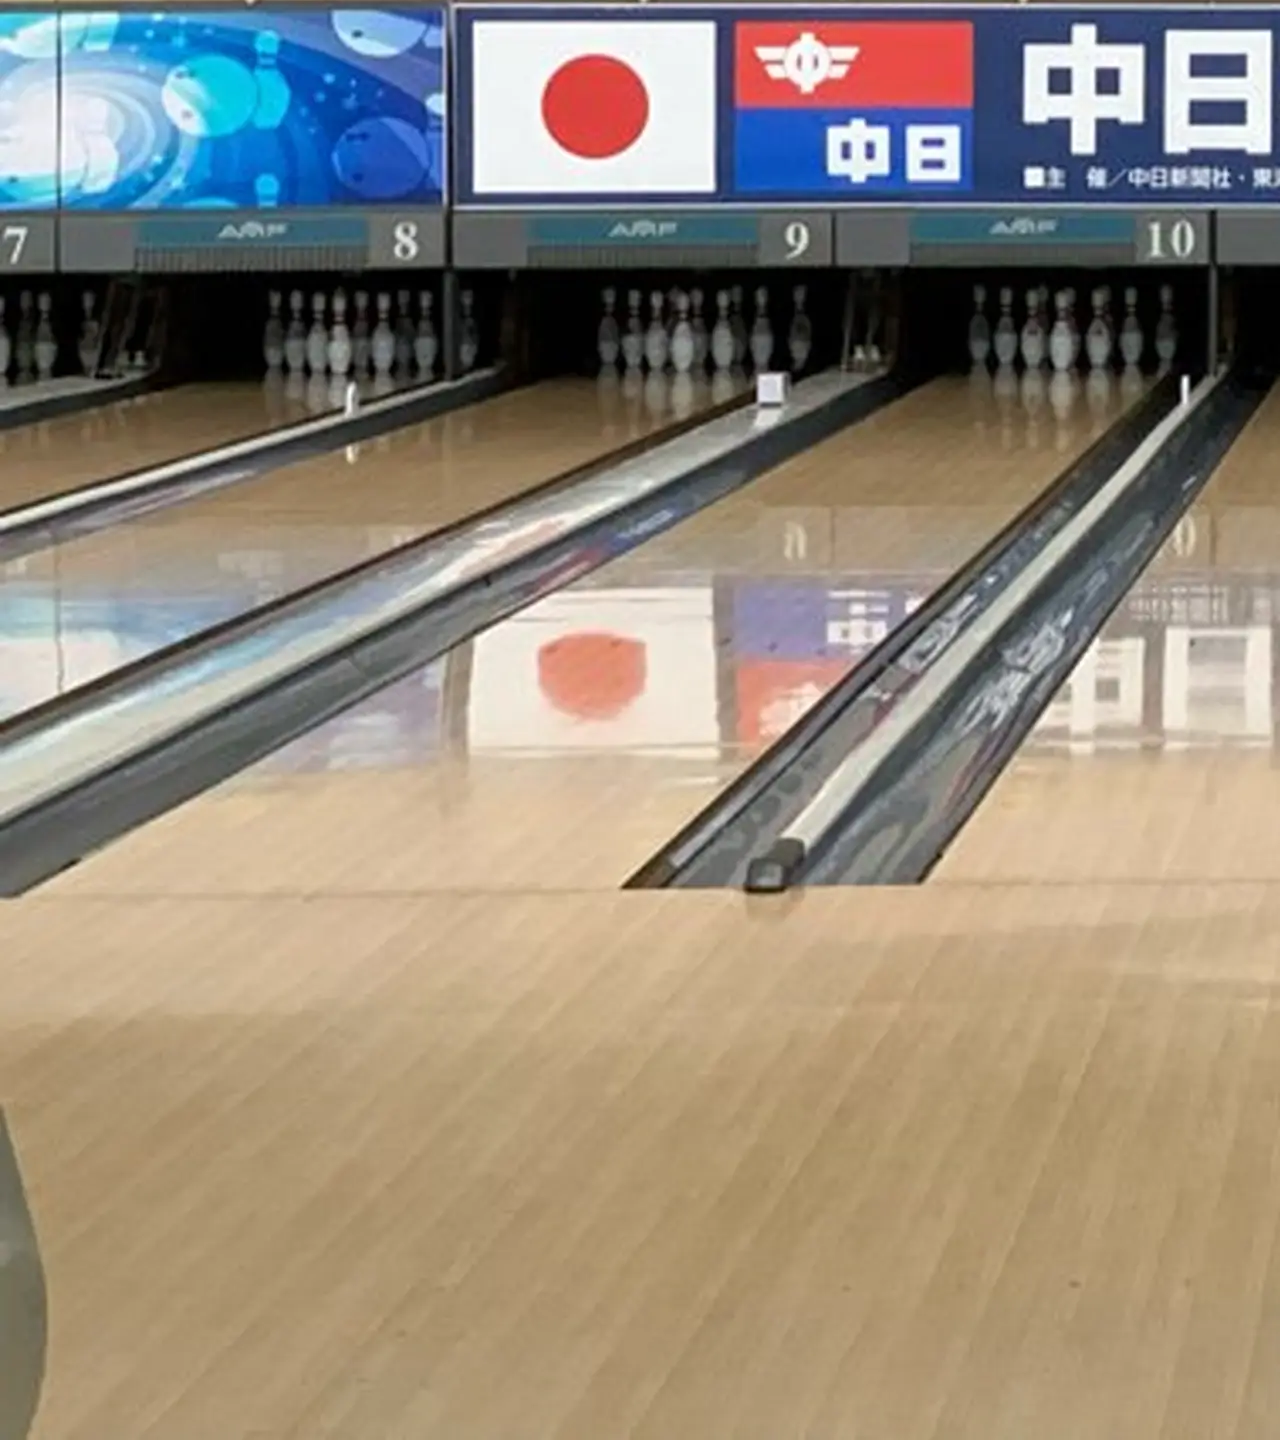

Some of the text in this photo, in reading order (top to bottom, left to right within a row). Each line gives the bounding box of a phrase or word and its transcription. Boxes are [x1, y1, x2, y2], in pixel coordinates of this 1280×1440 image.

[827, 118, 961, 183] 中日
[4, 226, 28, 264] 7
[393, 223, 419, 259] 8
[785, 223, 810, 258] 9
[1147, 221, 1195, 258] 10
